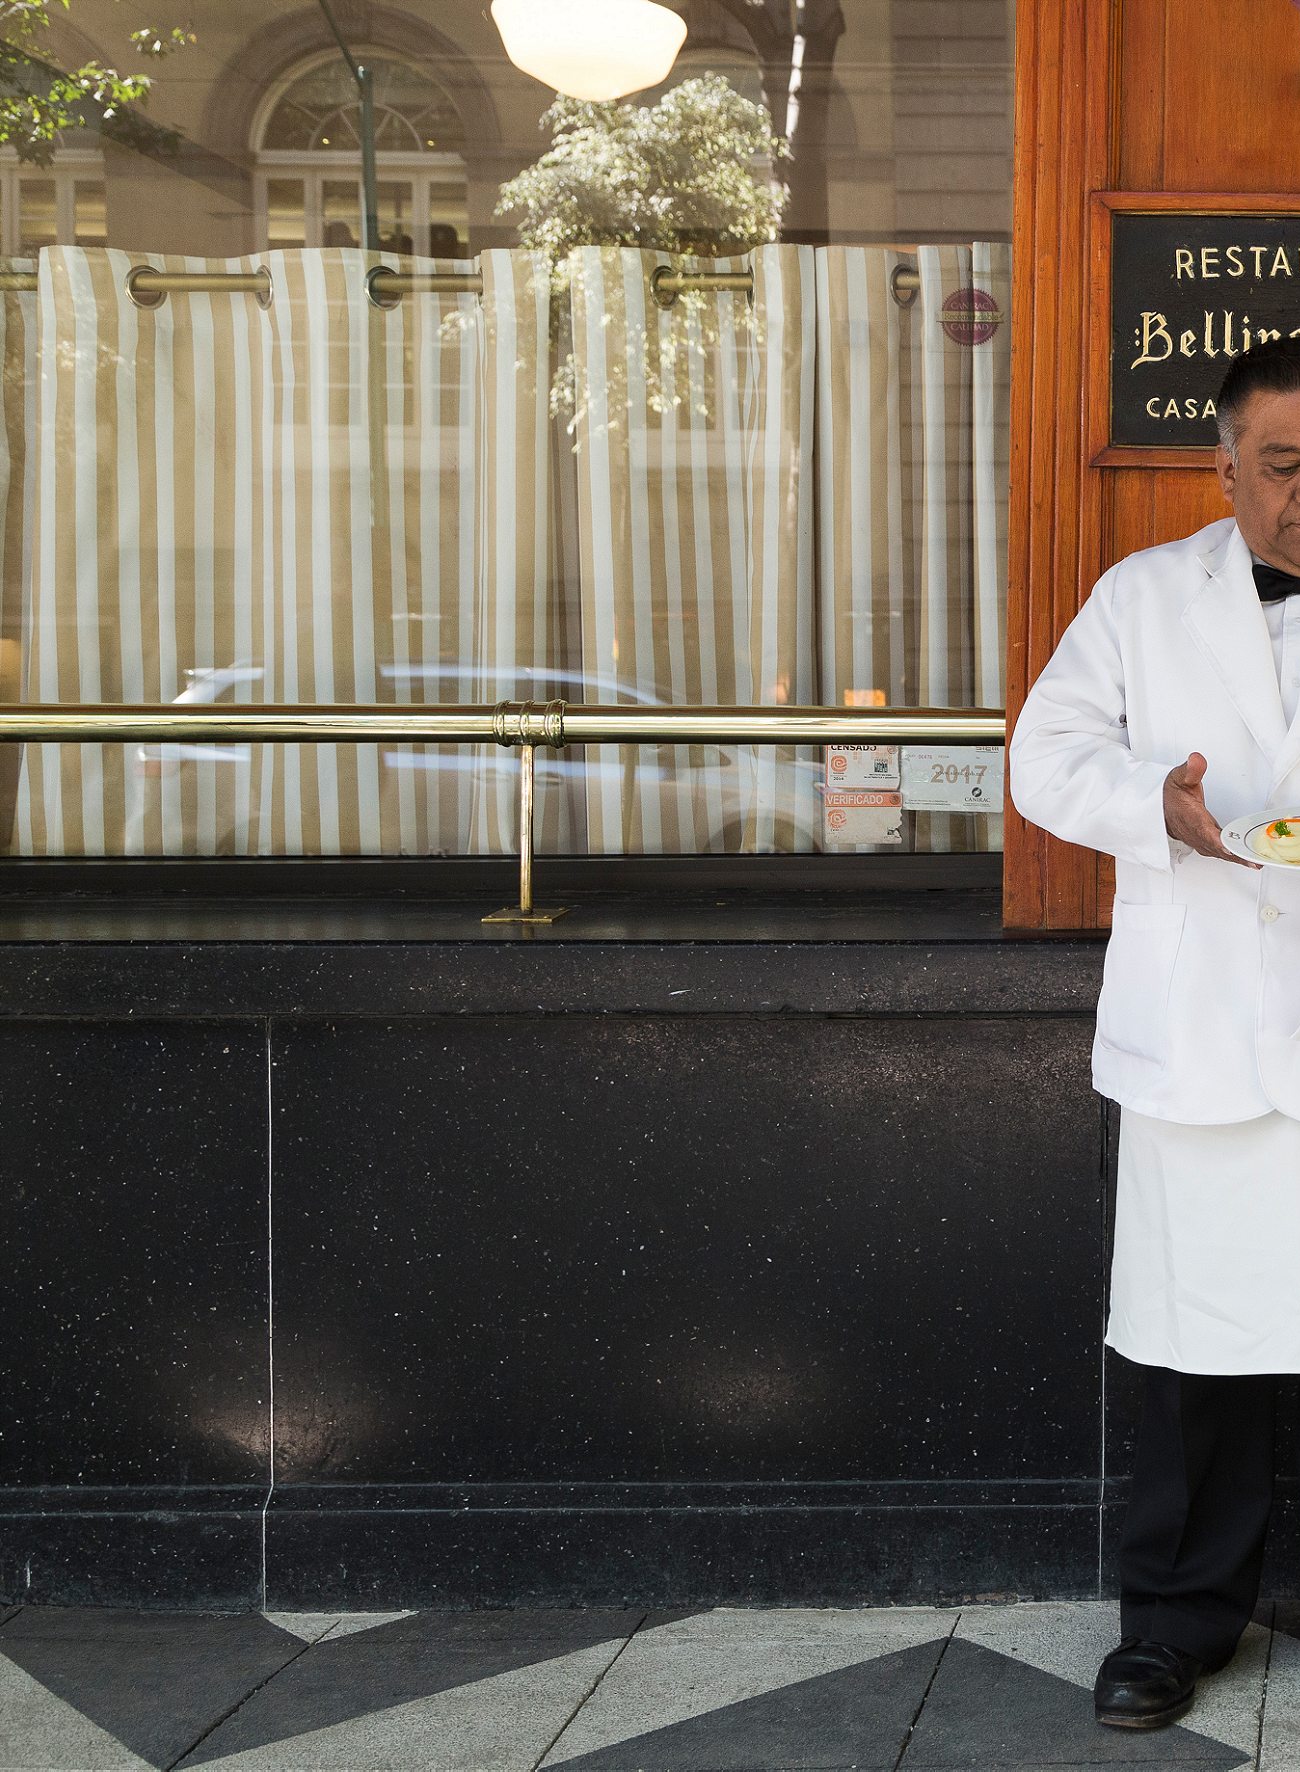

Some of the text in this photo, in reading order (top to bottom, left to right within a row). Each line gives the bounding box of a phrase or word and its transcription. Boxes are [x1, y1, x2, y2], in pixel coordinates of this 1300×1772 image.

[950, 302, 990, 310] CANRAC
[1146, 397, 1217, 420] CASA
[930, 763, 988, 784] 2017
[827, 795, 884, 805] VERIFICADO
